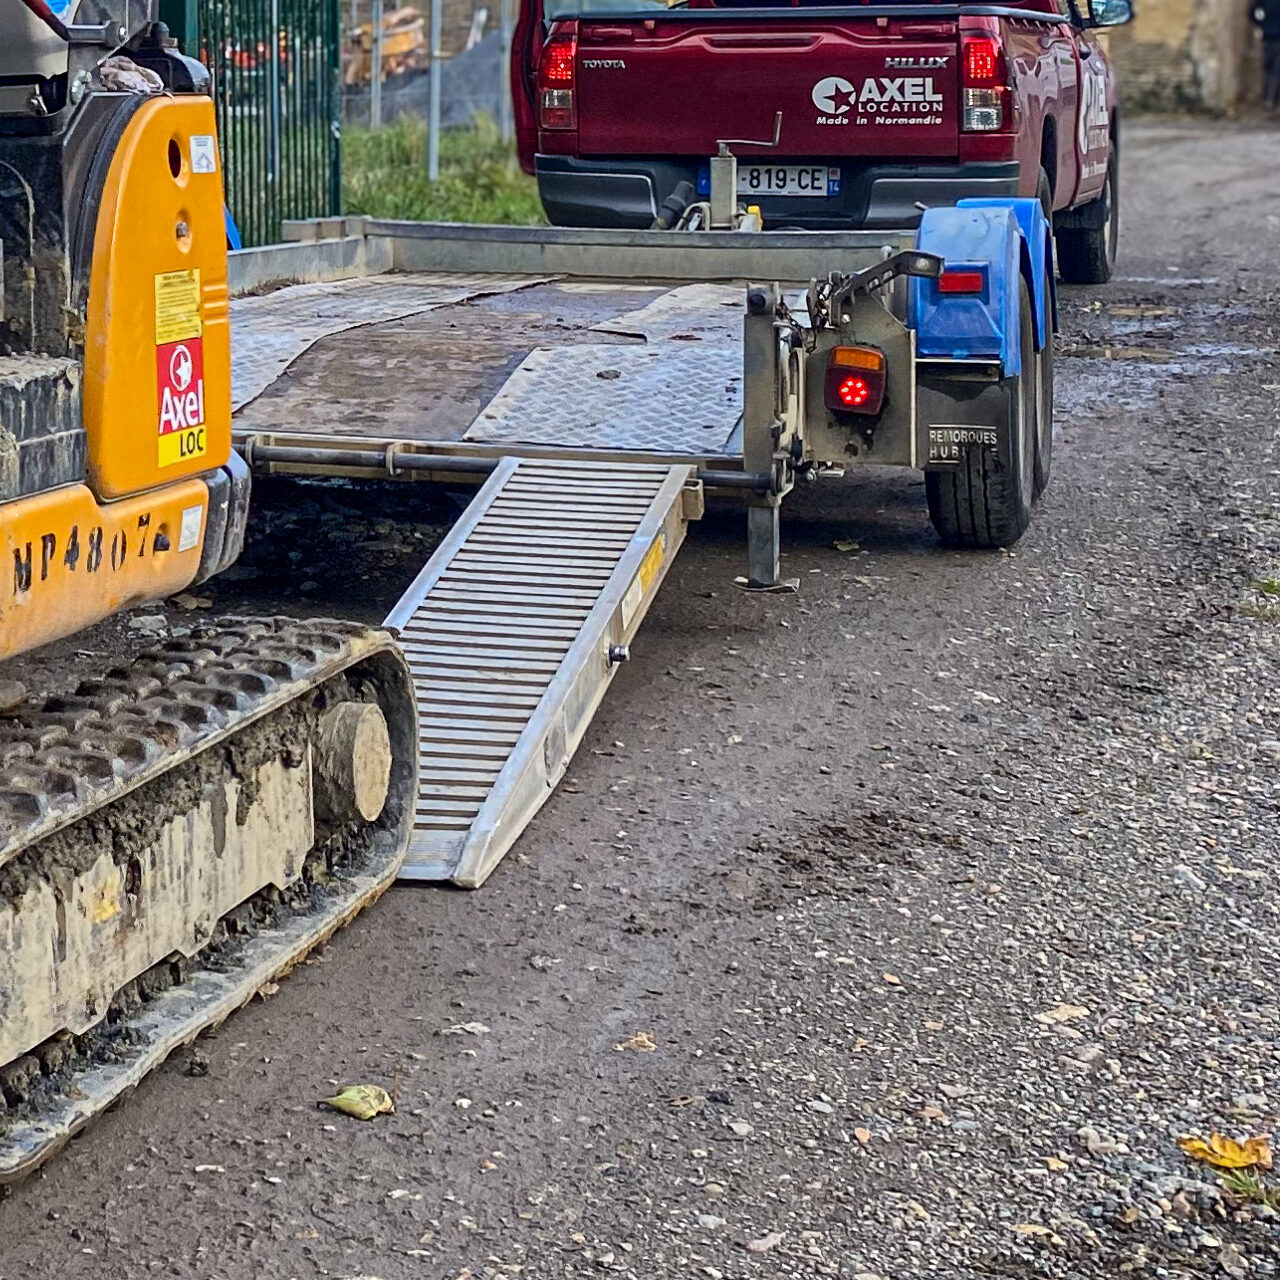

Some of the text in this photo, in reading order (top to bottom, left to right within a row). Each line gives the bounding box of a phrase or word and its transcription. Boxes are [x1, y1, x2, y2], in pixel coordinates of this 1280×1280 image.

[582, 59, 626, 69] TOYOTA
[885, 56, 949, 69] HILUX
[858, 77, 943, 102] AXEL
[858, 102, 943, 113] LOCATION
[816, 115, 943, 125] Made in Normandie
[740, 168, 823, 190] -819-CE
[158, 378, 205, 435] Axel
[180, 428, 205, 458] LOC
[928, 430, 998, 445] REMORQUES
